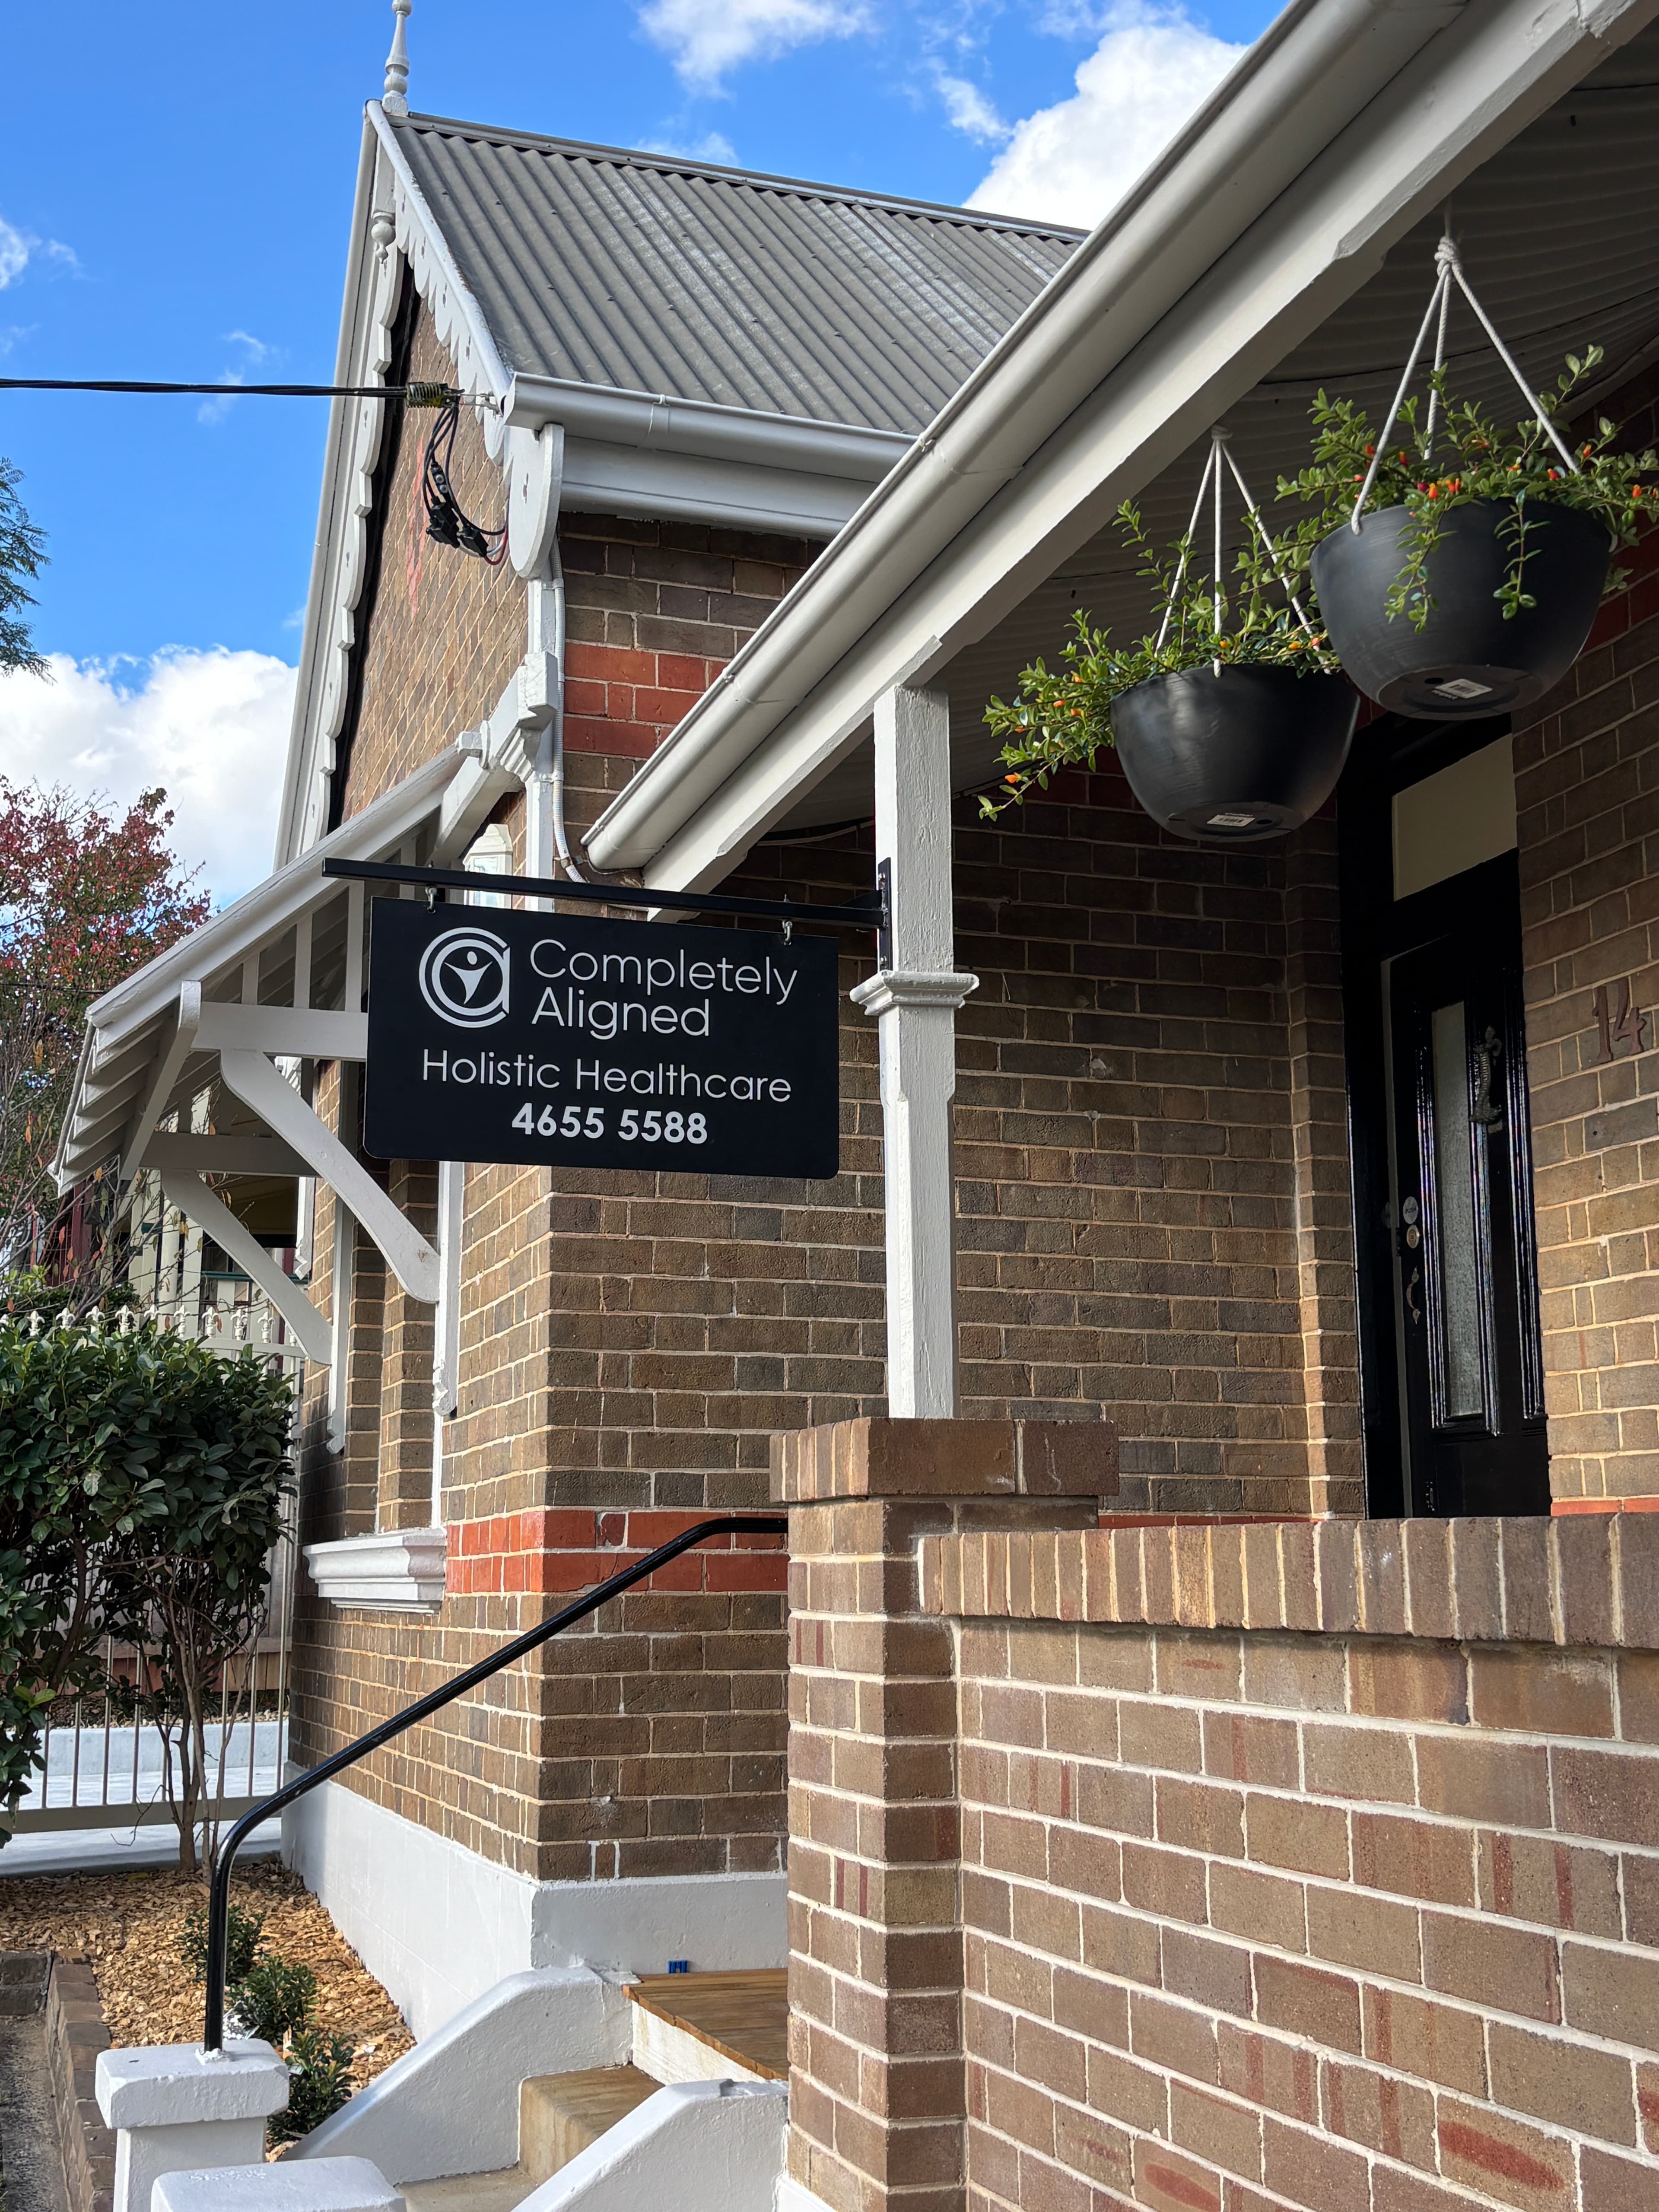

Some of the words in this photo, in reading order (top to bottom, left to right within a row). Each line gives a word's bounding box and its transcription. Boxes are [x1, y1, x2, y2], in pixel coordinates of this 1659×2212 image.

[530, 938, 798, 1005] Completely
[531, 986, 709, 1040] Aligned
[423, 1048, 560, 1089] Holistic
[576, 1058, 791, 1103] Healthcare
[511, 1102, 605, 1139] 4655
[617, 1109, 708, 1144] 5588
